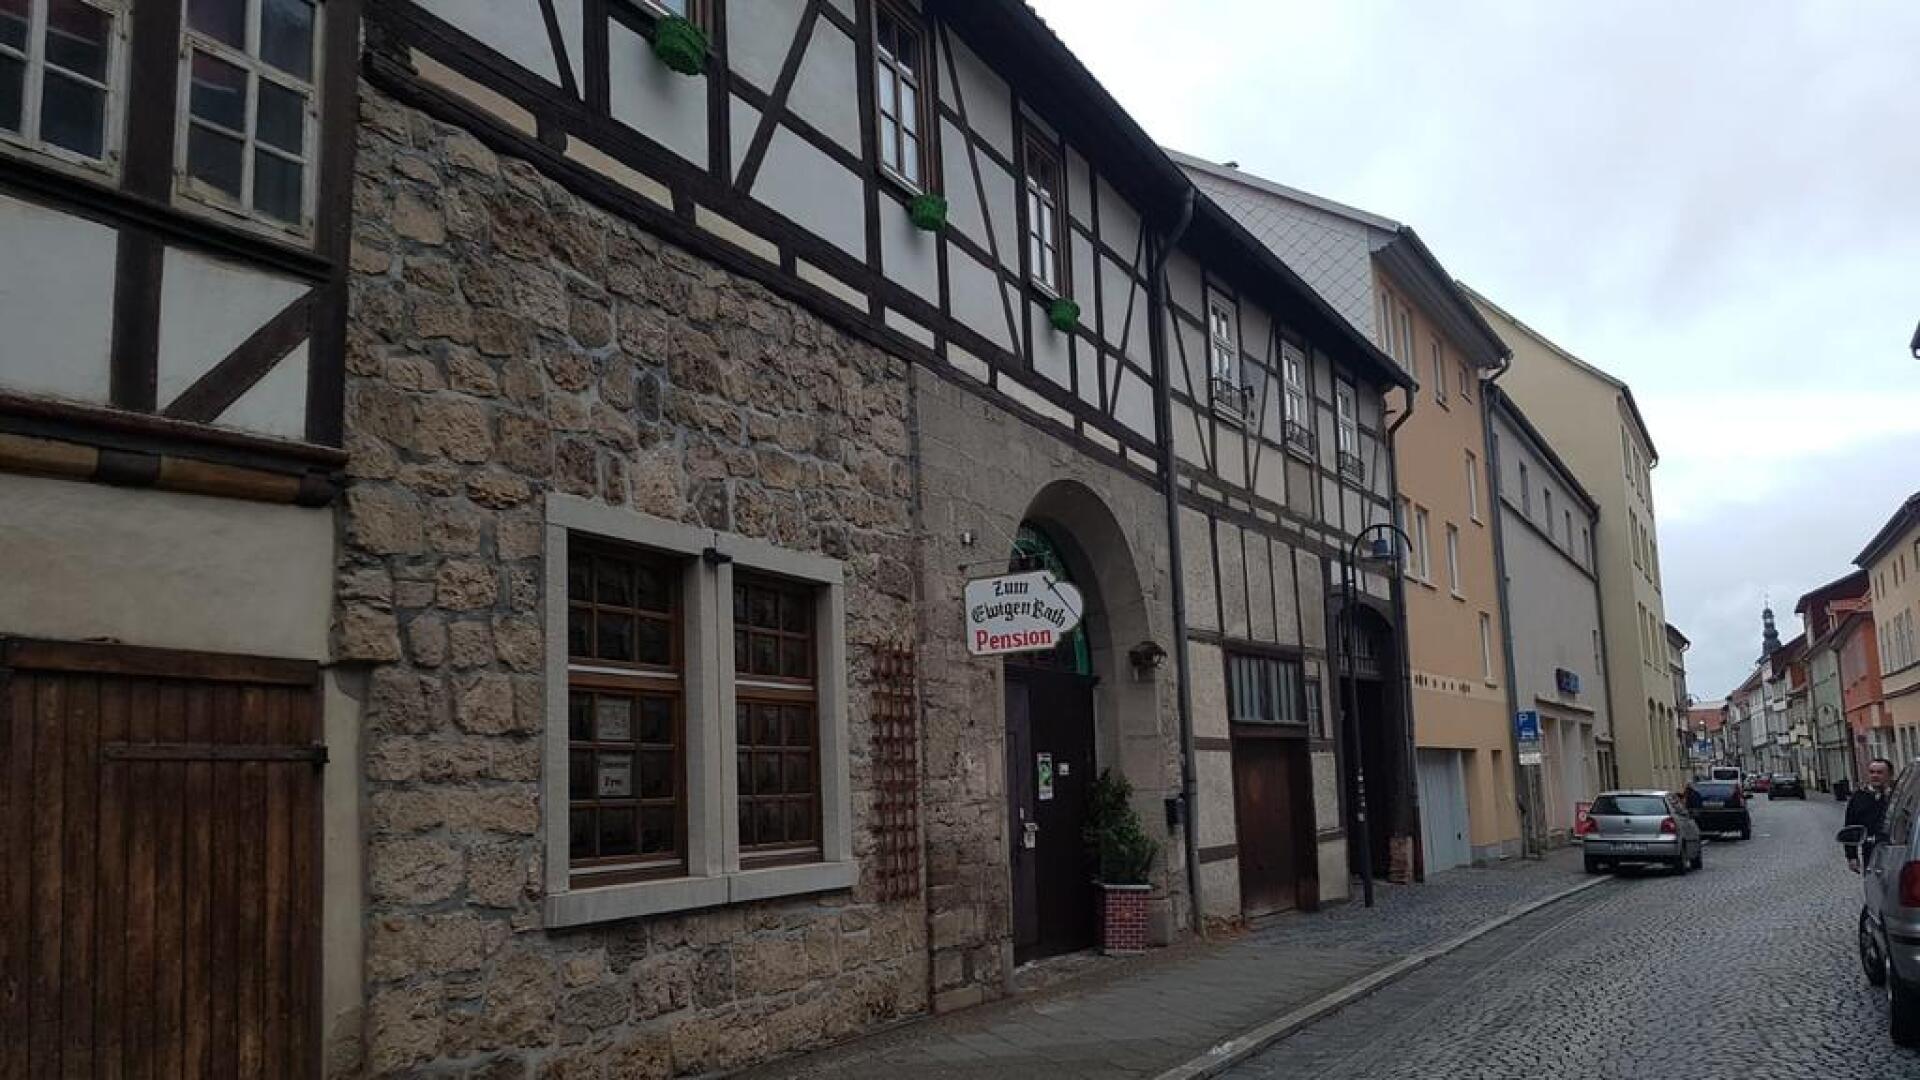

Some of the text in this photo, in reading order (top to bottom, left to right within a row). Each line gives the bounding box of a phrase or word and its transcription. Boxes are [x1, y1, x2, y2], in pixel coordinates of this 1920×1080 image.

[992, 580, 1030, 597] Zum
[971, 601, 1031, 624] Ewigen
[976, 629, 1052, 652] Pension
